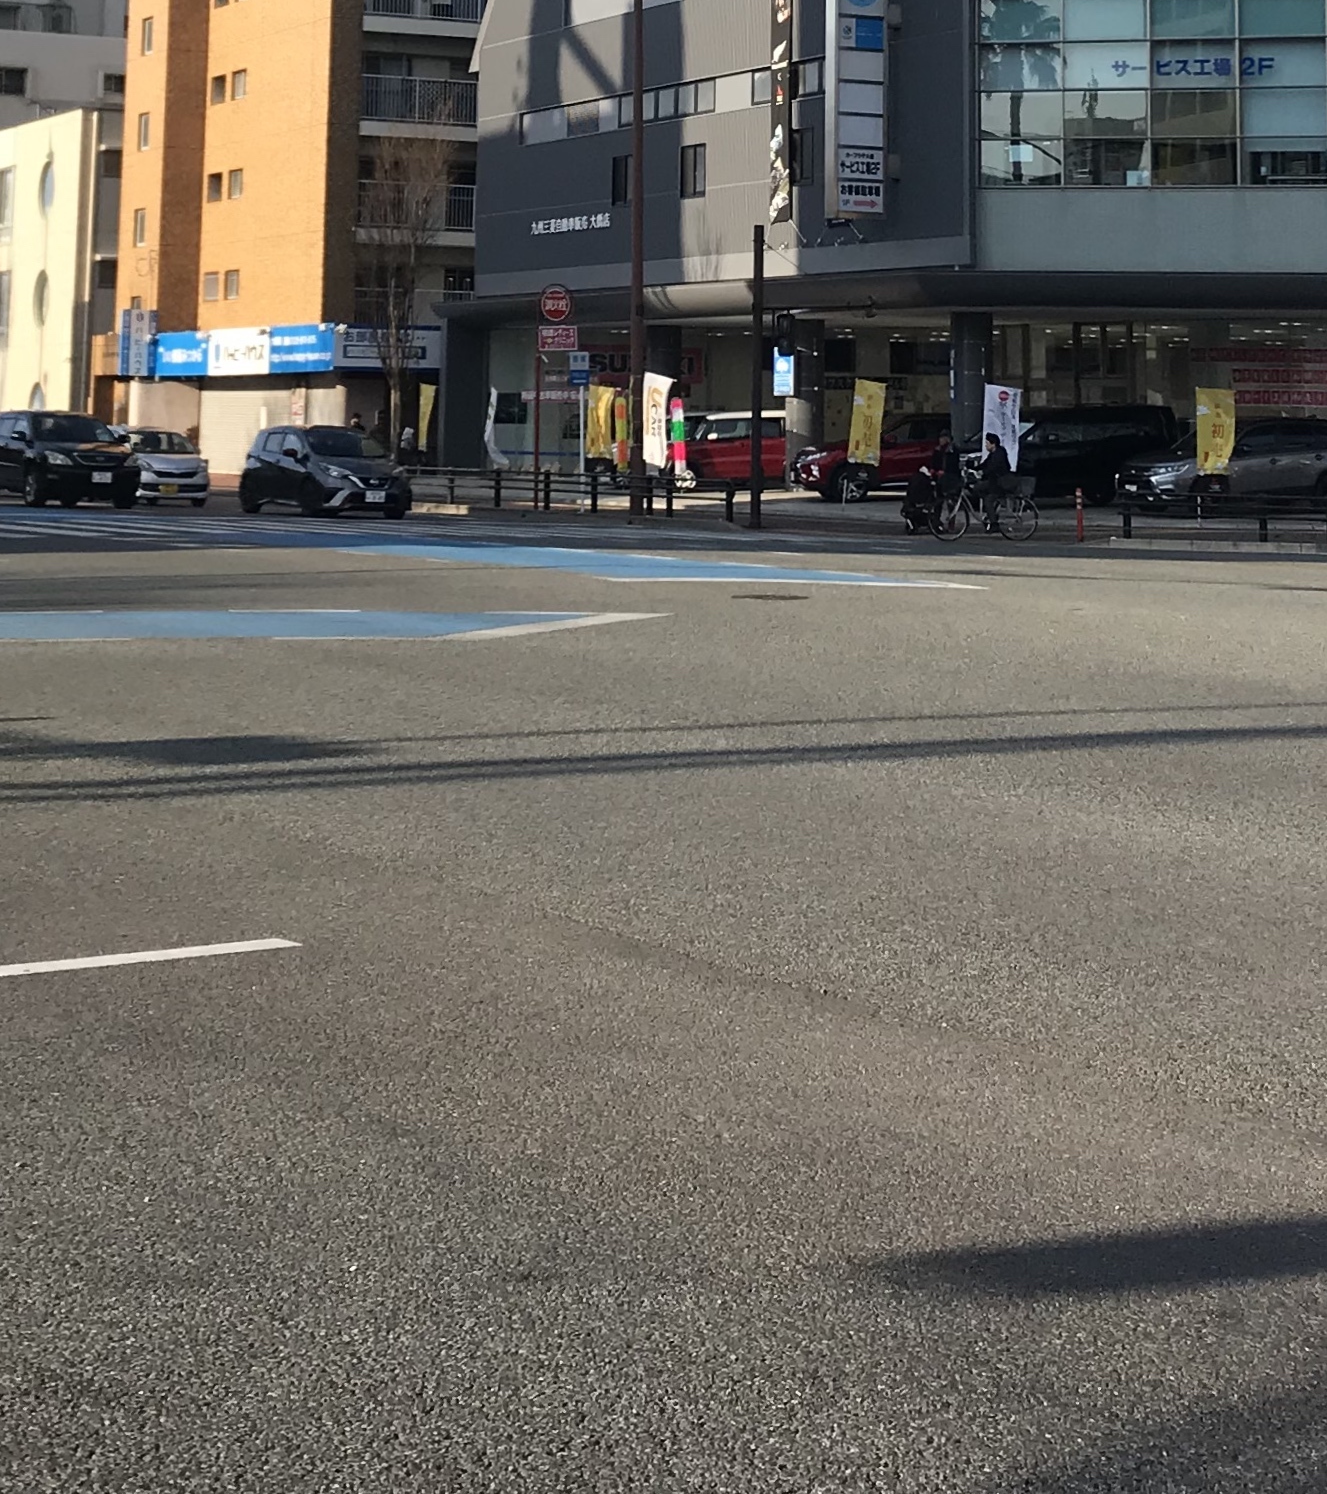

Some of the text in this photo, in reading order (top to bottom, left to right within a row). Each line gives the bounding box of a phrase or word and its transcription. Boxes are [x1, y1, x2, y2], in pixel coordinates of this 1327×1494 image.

[1111, 56, 1276, 77] サービス工場 2F
